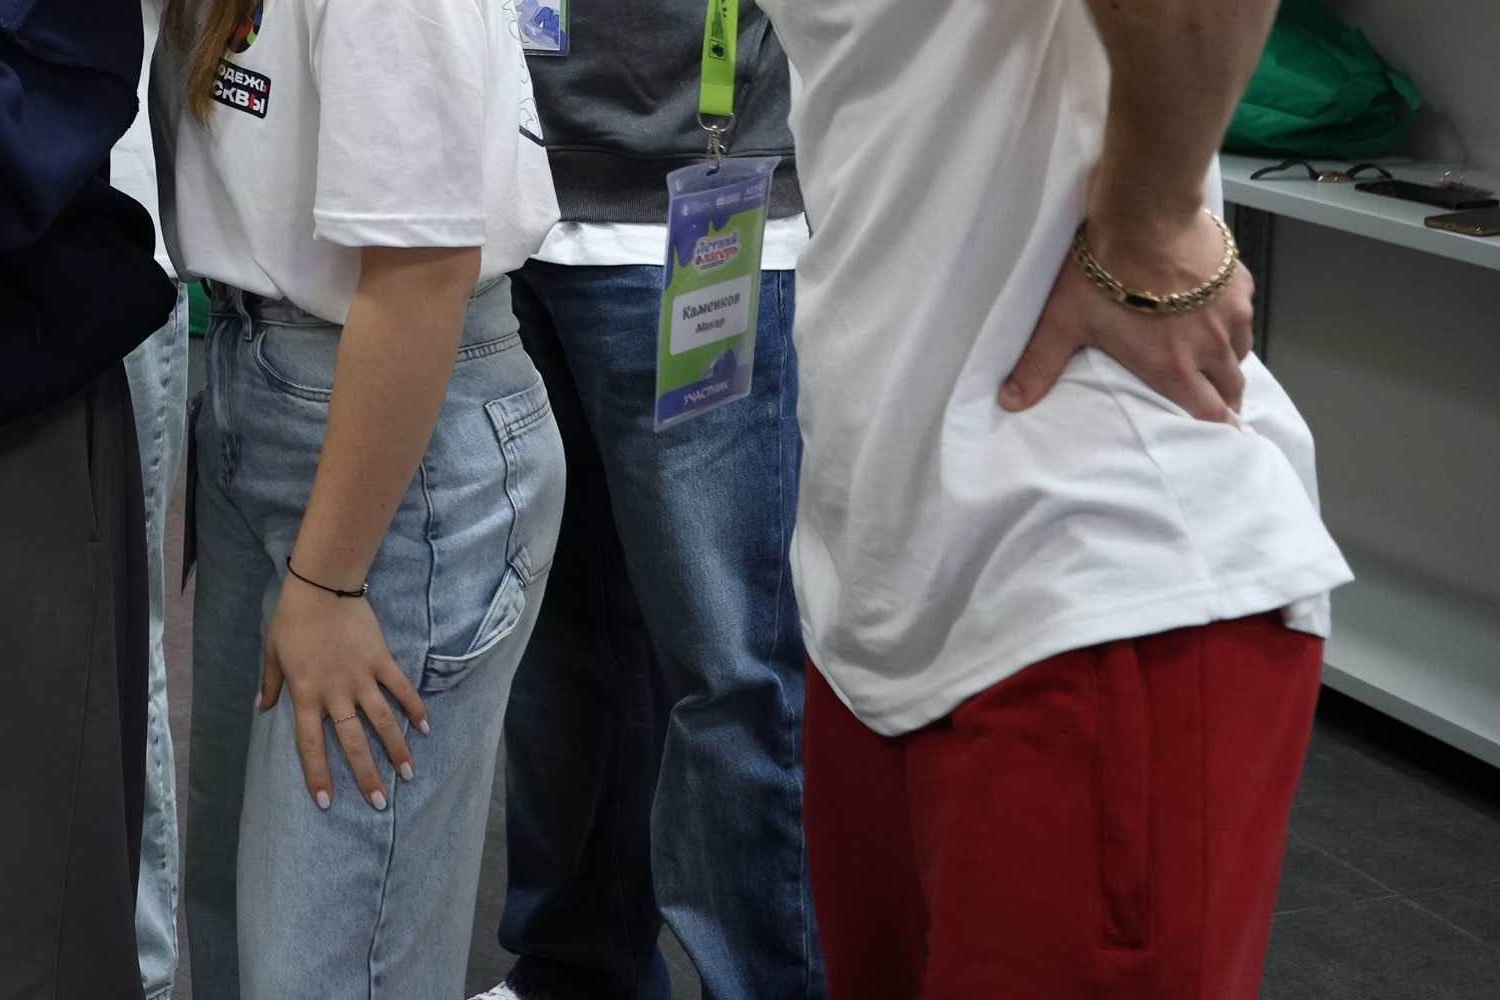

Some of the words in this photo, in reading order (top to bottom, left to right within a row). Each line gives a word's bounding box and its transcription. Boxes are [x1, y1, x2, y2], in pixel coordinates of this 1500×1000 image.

[211, 80, 265, 114] СКВЫ
[682, 293, 741, 321] Каменков
[695, 317, 726, 334] Макар
[683, 380, 730, 406] УЧАСТНИК
